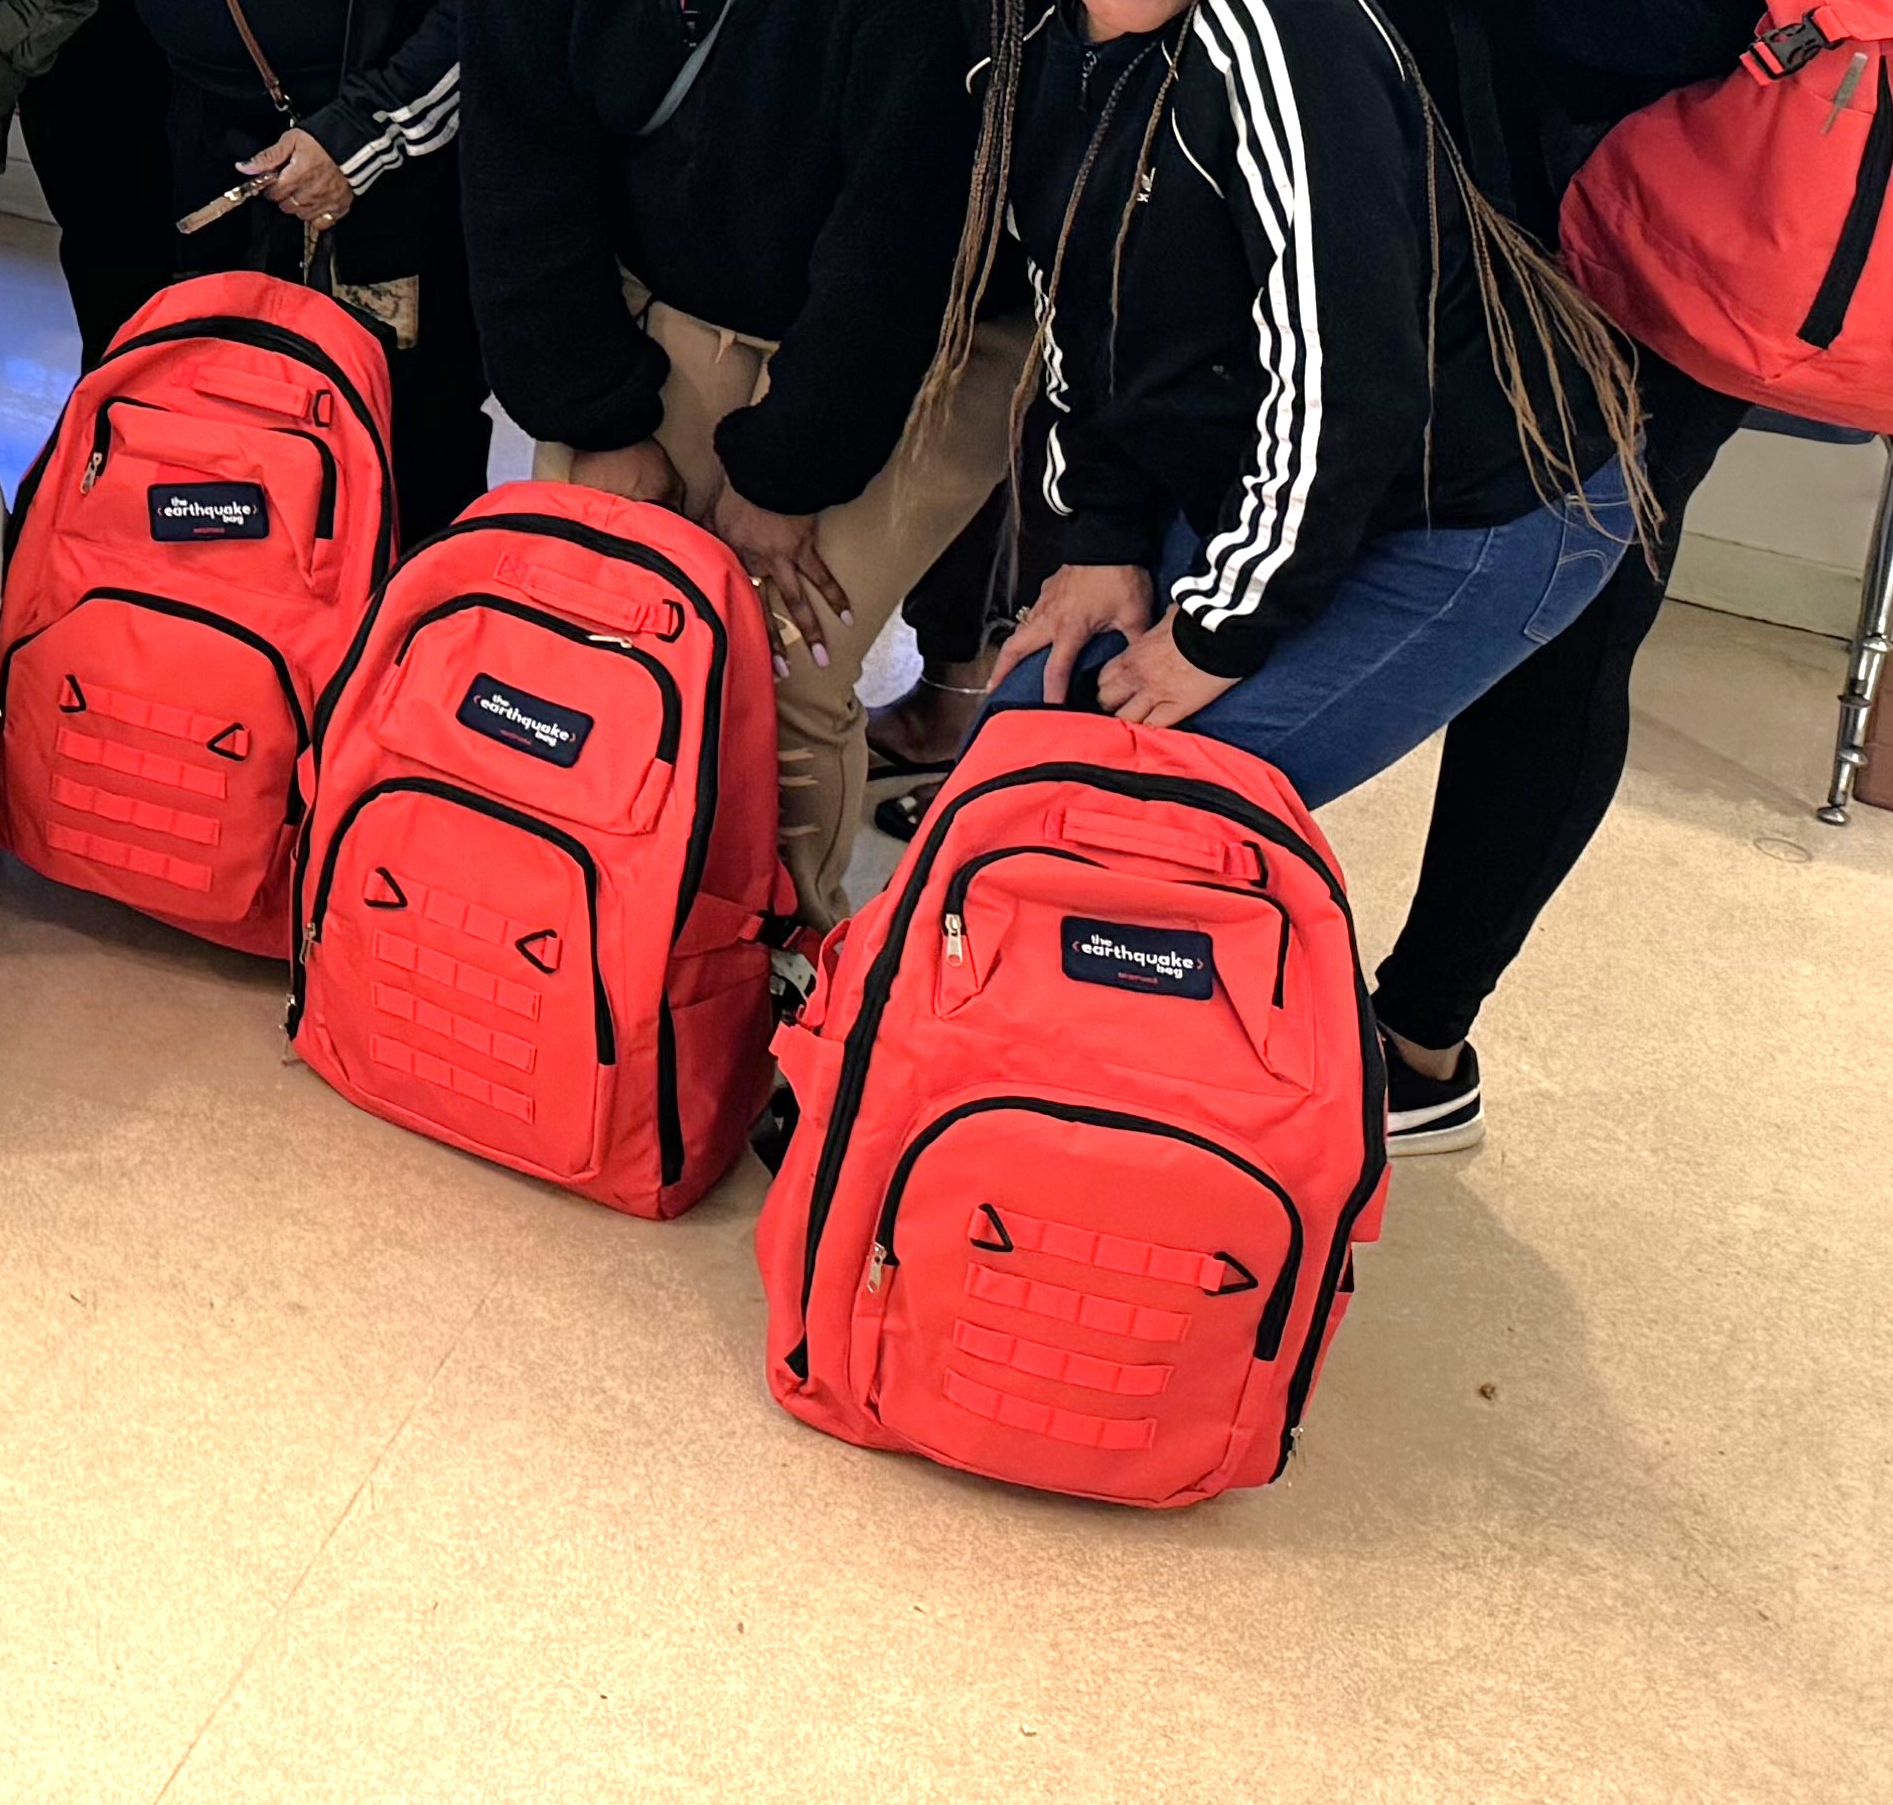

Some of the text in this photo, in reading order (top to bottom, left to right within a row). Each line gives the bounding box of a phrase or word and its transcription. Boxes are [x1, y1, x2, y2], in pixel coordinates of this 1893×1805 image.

[163, 500, 252, 520] earthquake
[169, 496, 188, 507] the
[222, 514, 244, 526] bag
[492, 693, 510, 707] the
[479, 698, 570, 742] earthquake
[534, 730, 558, 748] bag
[1090, 933, 1114, 947] the
[1080, 943, 1195, 969] earthquake
[1156, 963, 1184, 980] bag
